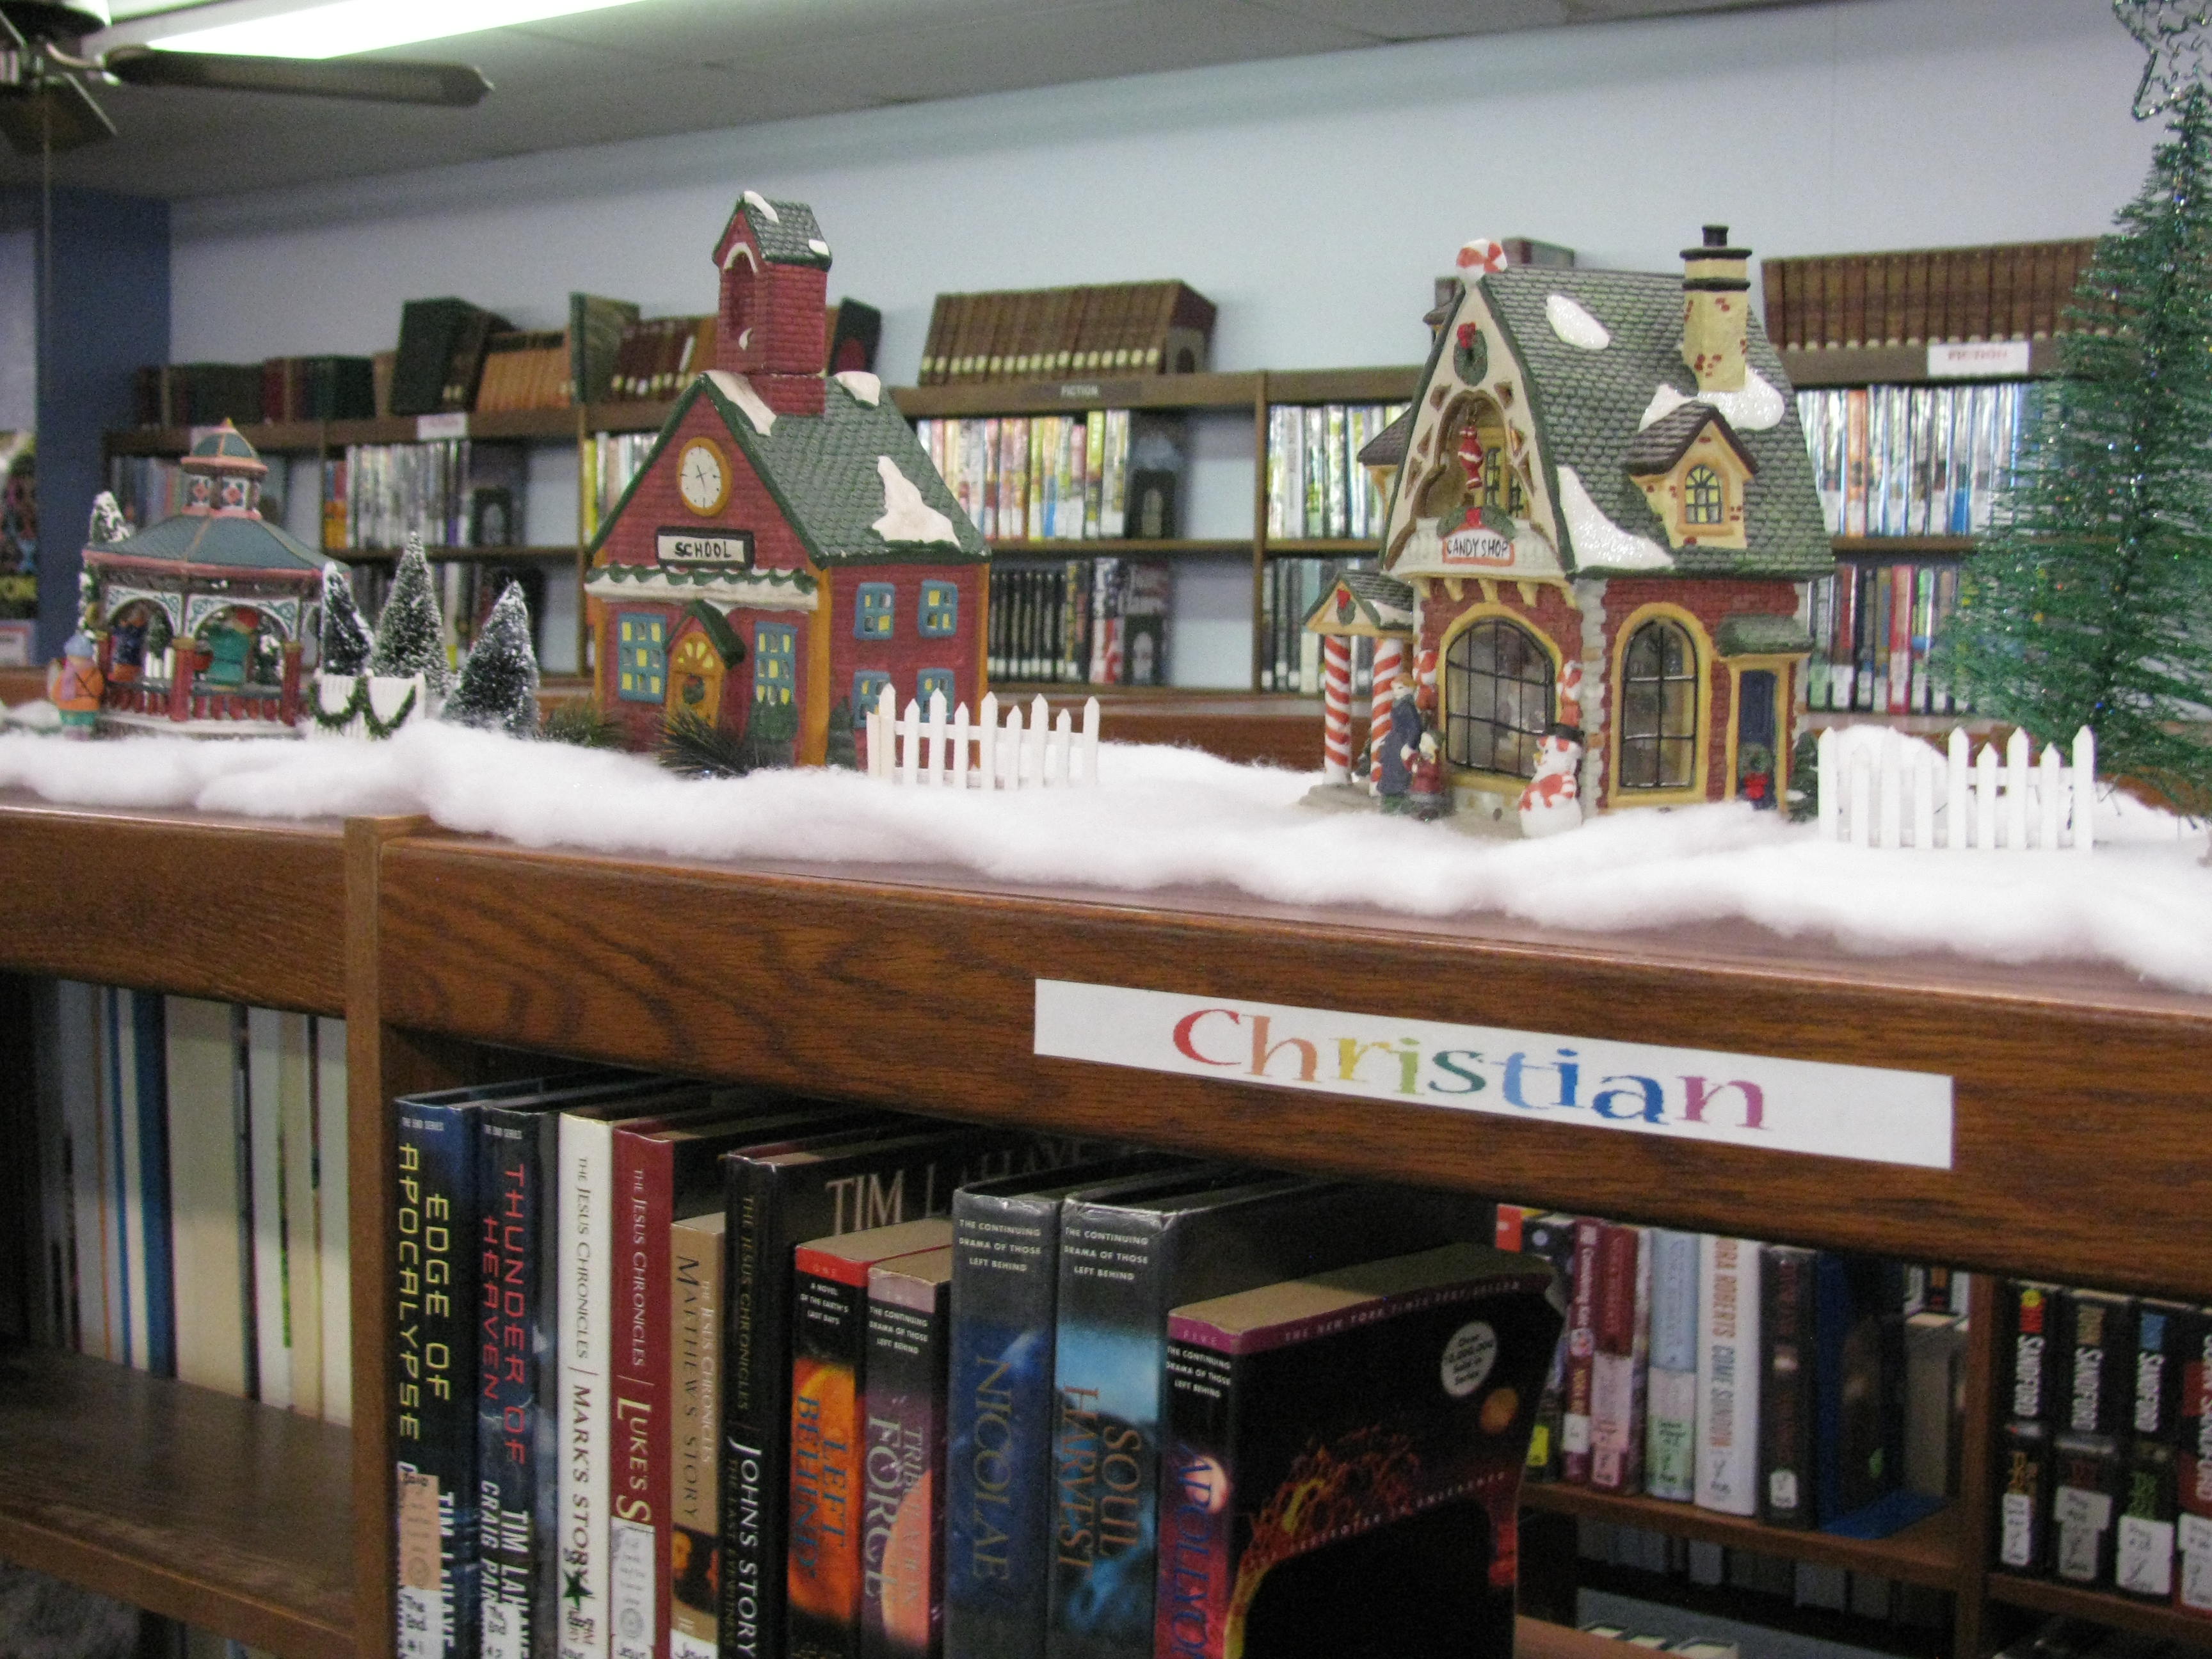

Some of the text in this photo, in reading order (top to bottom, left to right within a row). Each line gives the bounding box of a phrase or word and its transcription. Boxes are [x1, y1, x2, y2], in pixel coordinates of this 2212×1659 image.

[674, 541, 732, 558] SCHOOL
[1447, 539, 1508, 558] CANDY SHOP
[1171, 1008, 1775, 1130] Christian
[742, 1197, 754, 1228] THE
[826, 1170, 904, 1235] TIM
[959, 1219, 1041, 1237] THE CONTINUING
[1065, 1227, 1150, 1246] THE CONTINUING
[577, 1157, 591, 1360] THE JESUS CHRONICLES
[632, 1169, 648, 1367] THE JESUS CHRONICLES
[959, 1237, 1041, 1255] DRAMA OF THOSE
[968, 1257, 1028, 1272] LEFT BEHIND
[1063, 1246, 1148, 1265] DRAMA OF THOSE
[1073, 1265, 1135, 1281] LEFT BEHIND
[1714, 1238, 1738, 1269] ORA
[399, 1142, 420, 1440] APOCALYPSE
[425, 1193, 450, 1401] EDGE OF
[483, 1215, 500, 1400] HEAVEN
[504, 1163, 526, 1465] THUNDER OF
[884, 1310, 928, 1327] CONTINUING
[1711, 1273, 1738, 1338] ROBERTS
[906, 1329, 928, 1342] THOSE
[1182, 1349, 1231, 1370] CONTINUING
[2014, 1334, 2046, 1417] SANDFORD
[675, 1254, 700, 1517] MATTHEWS STORY
[701, 1356, 716, 1463] CHRONICLES
[1208, 1372, 1232, 1386] THOSE
[2071, 1347, 2104, 1431] SANDFORD
[2133, 1351, 2167, 1433] SANDFORD
[572, 1384, 591, 1483] MARK'S
[616, 1397, 652, 1491] LUKE'S
[973, 1356, 1013, 1581] NICOLAE
[481, 1480, 501, 1549] CRAIG
[795, 1395, 820, 1573] BEHIND
[822, 1437, 847, 1548] LEFT
[865, 1415, 901, 1598] FORCE
[1057, 1384, 1100, 1580] HARVEST
[1100, 1425, 1142, 1556] SOUL
[501, 1511, 529, 1554] TIM
[728, 1436, 762, 1658] JOHN'S STORY
